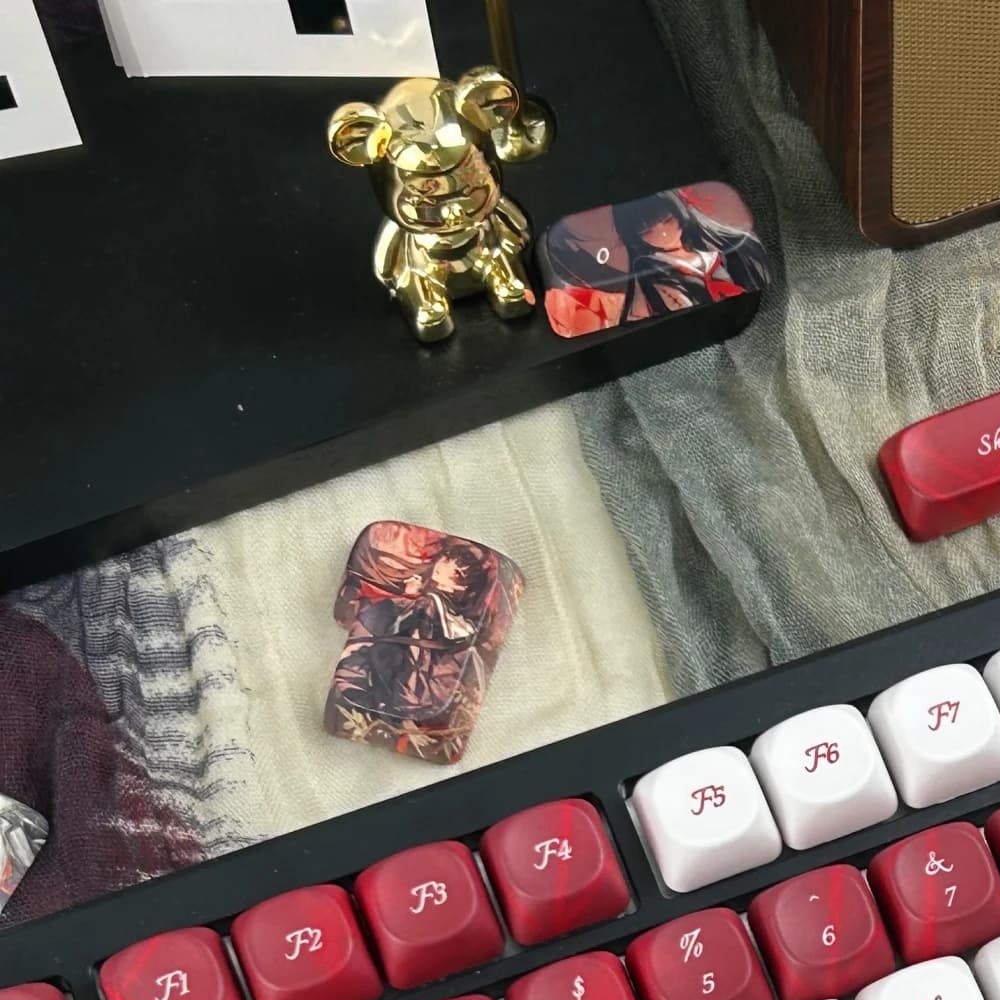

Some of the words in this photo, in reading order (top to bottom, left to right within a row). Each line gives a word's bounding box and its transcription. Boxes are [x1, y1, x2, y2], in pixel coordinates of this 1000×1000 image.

[927, 700, 961, 732] F7
[804, 742, 840, 774] F6
[690, 784, 726, 816] F5
[533, 837, 573, 871] F4
[924, 851, 954, 876] &
[409, 880, 448, 914] F3
[944, 885, 957, 907] 7
[284, 927, 323, 961] F2
[679, 927, 704, 963] %
[821, 924, 836, 946] 6
[702, 972, 715, 994] 5
